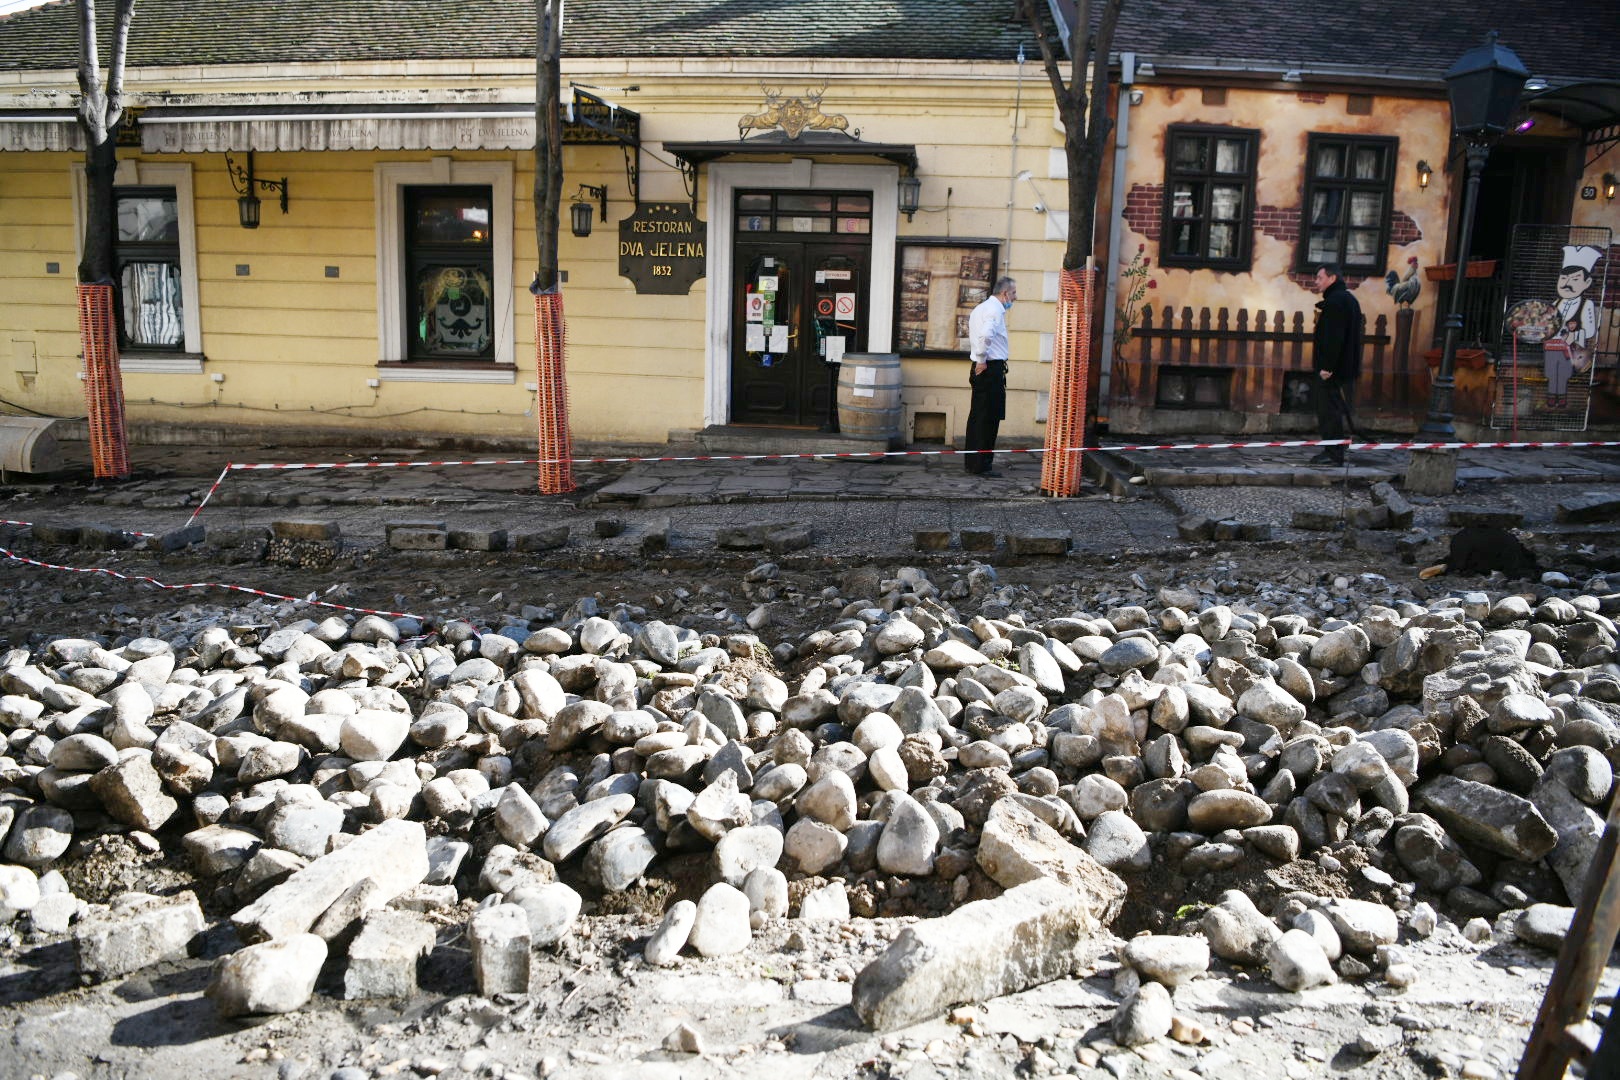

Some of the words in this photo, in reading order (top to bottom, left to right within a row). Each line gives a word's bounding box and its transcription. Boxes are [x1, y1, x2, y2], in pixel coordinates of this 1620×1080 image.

[478, 128, 497, 137] DVA
[497, 128, 529, 137] JELENA
[633, 221, 692, 233] RESTORAN
[620, 241, 644, 256] DVA
[650, 242, 704, 257] JELENA
[653, 265, 672, 276] 1832
